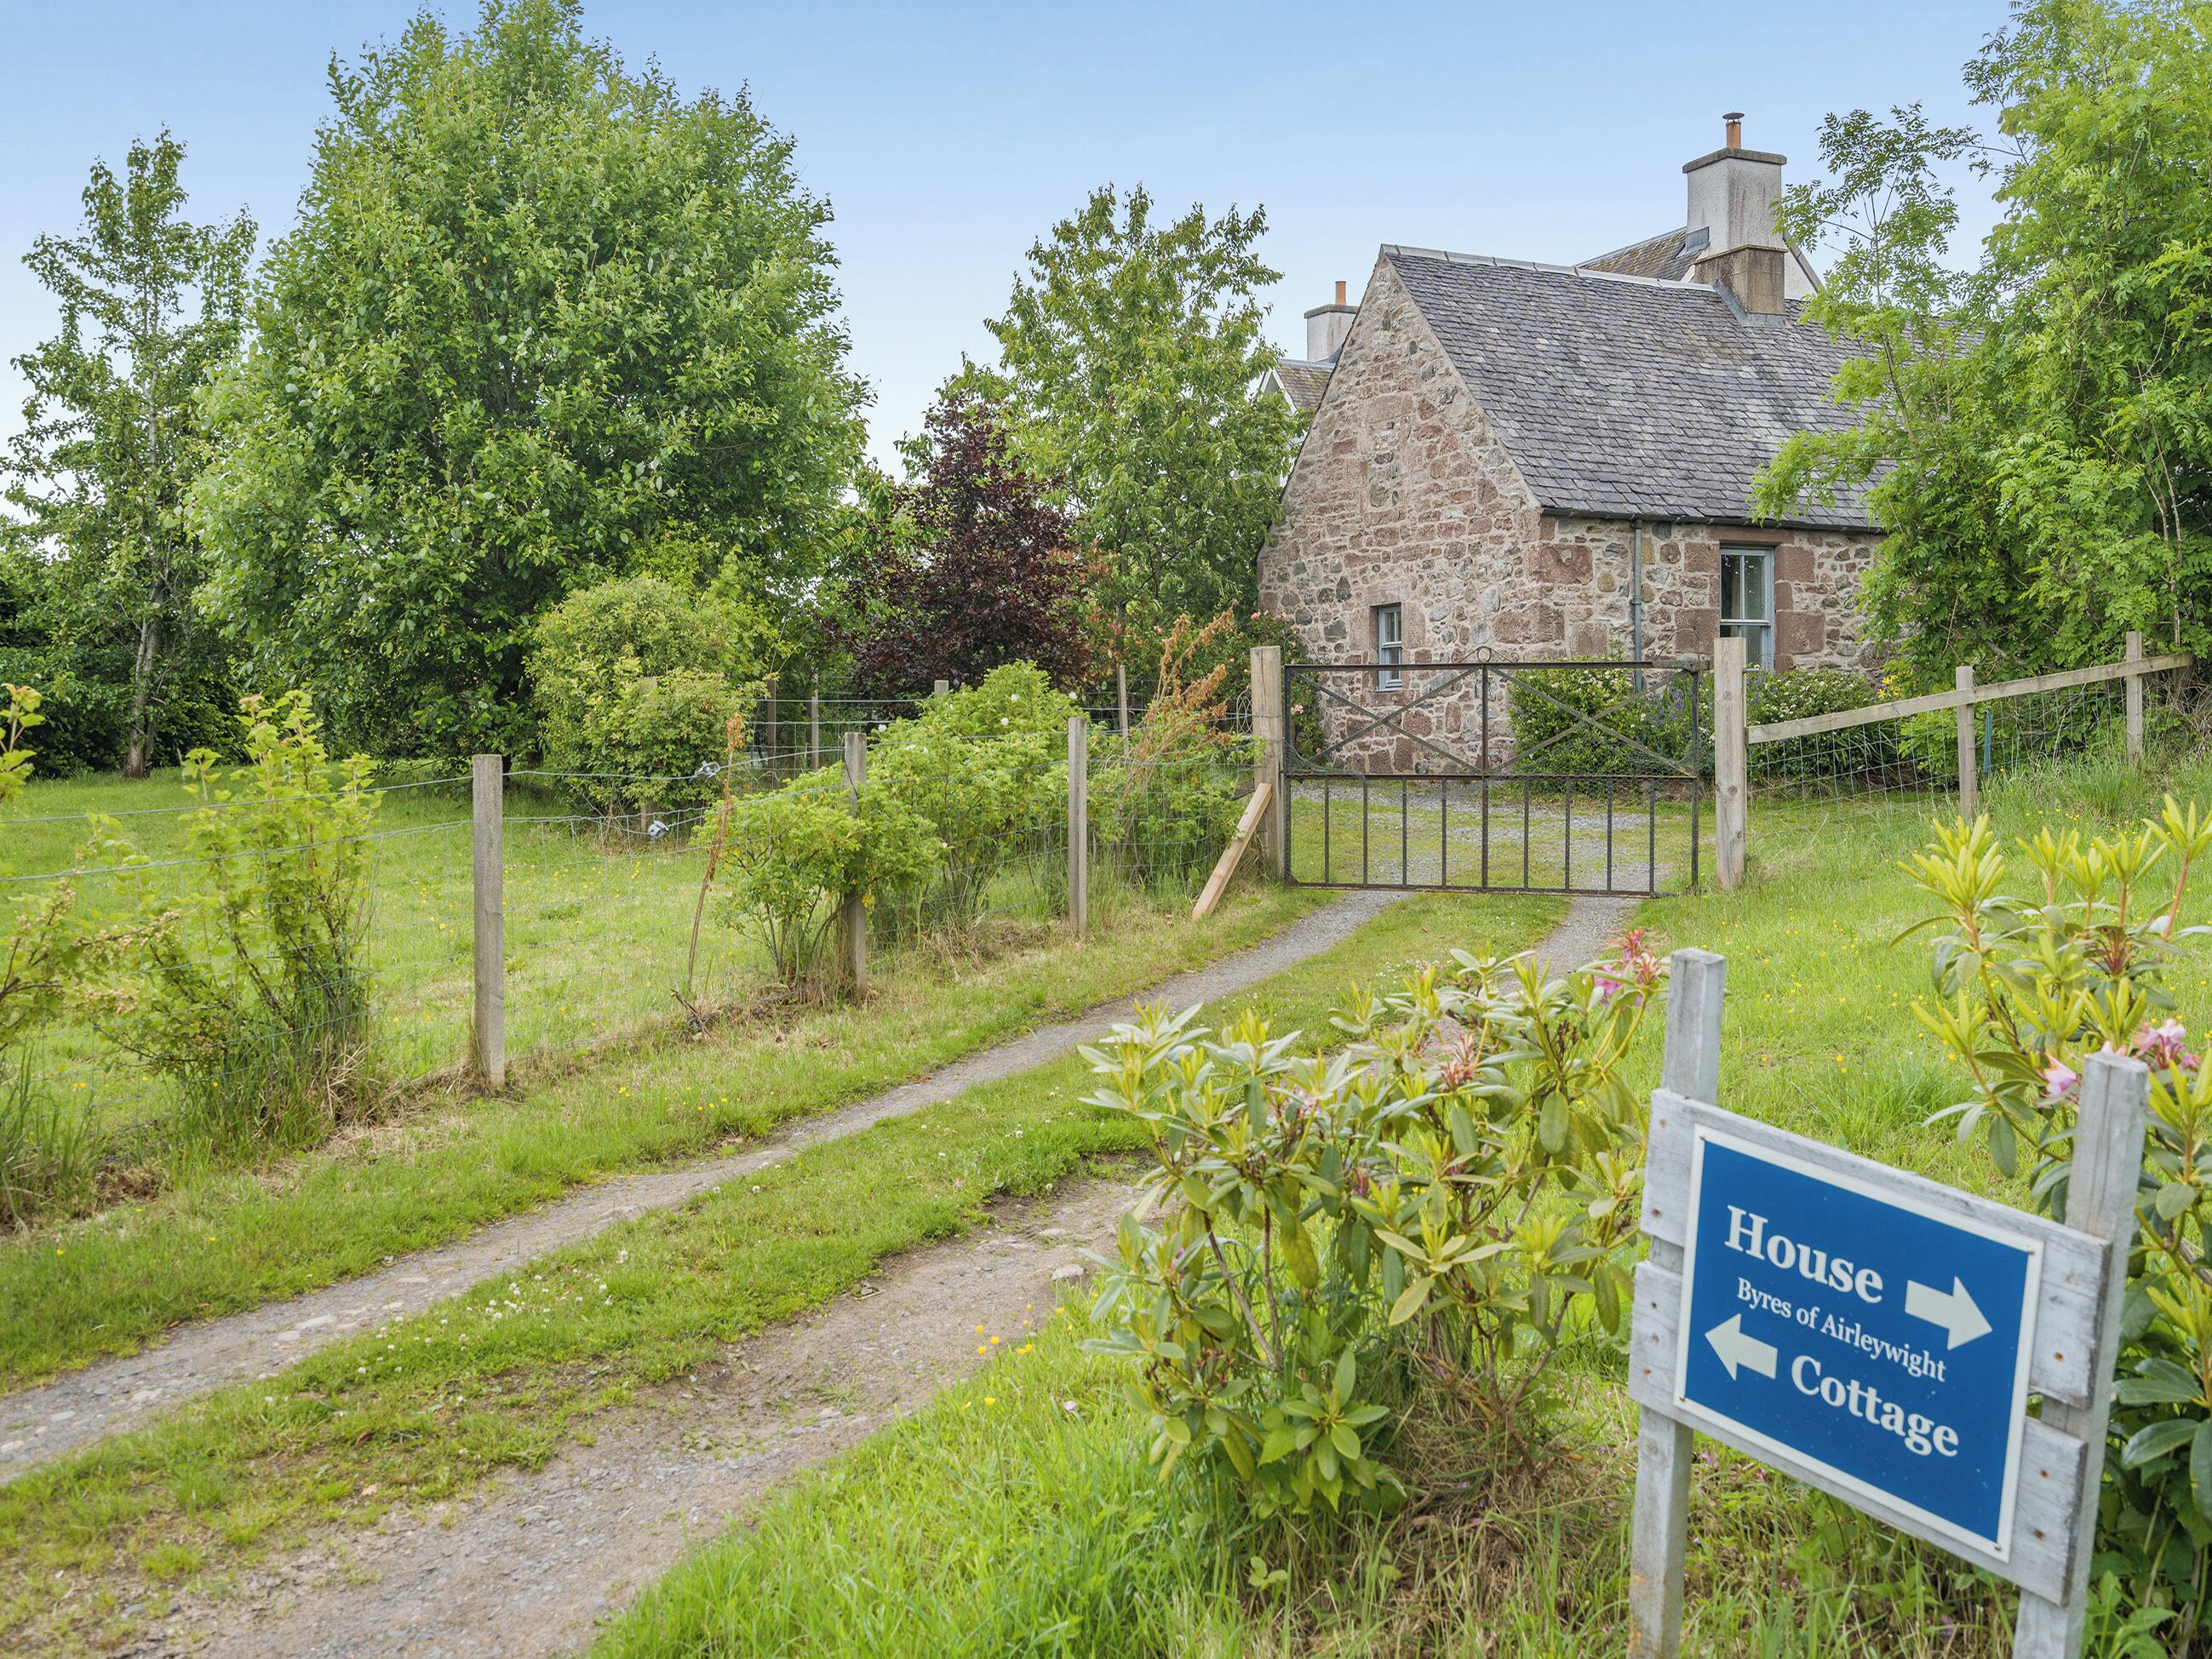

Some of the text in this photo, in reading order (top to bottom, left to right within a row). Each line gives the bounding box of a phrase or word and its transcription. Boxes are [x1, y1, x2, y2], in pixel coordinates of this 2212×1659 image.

[1724, 1204, 1883, 1303] House
[1737, 1278, 1946, 1384] Byres of Airleywight
[1791, 1355, 1959, 1456] Cottage
